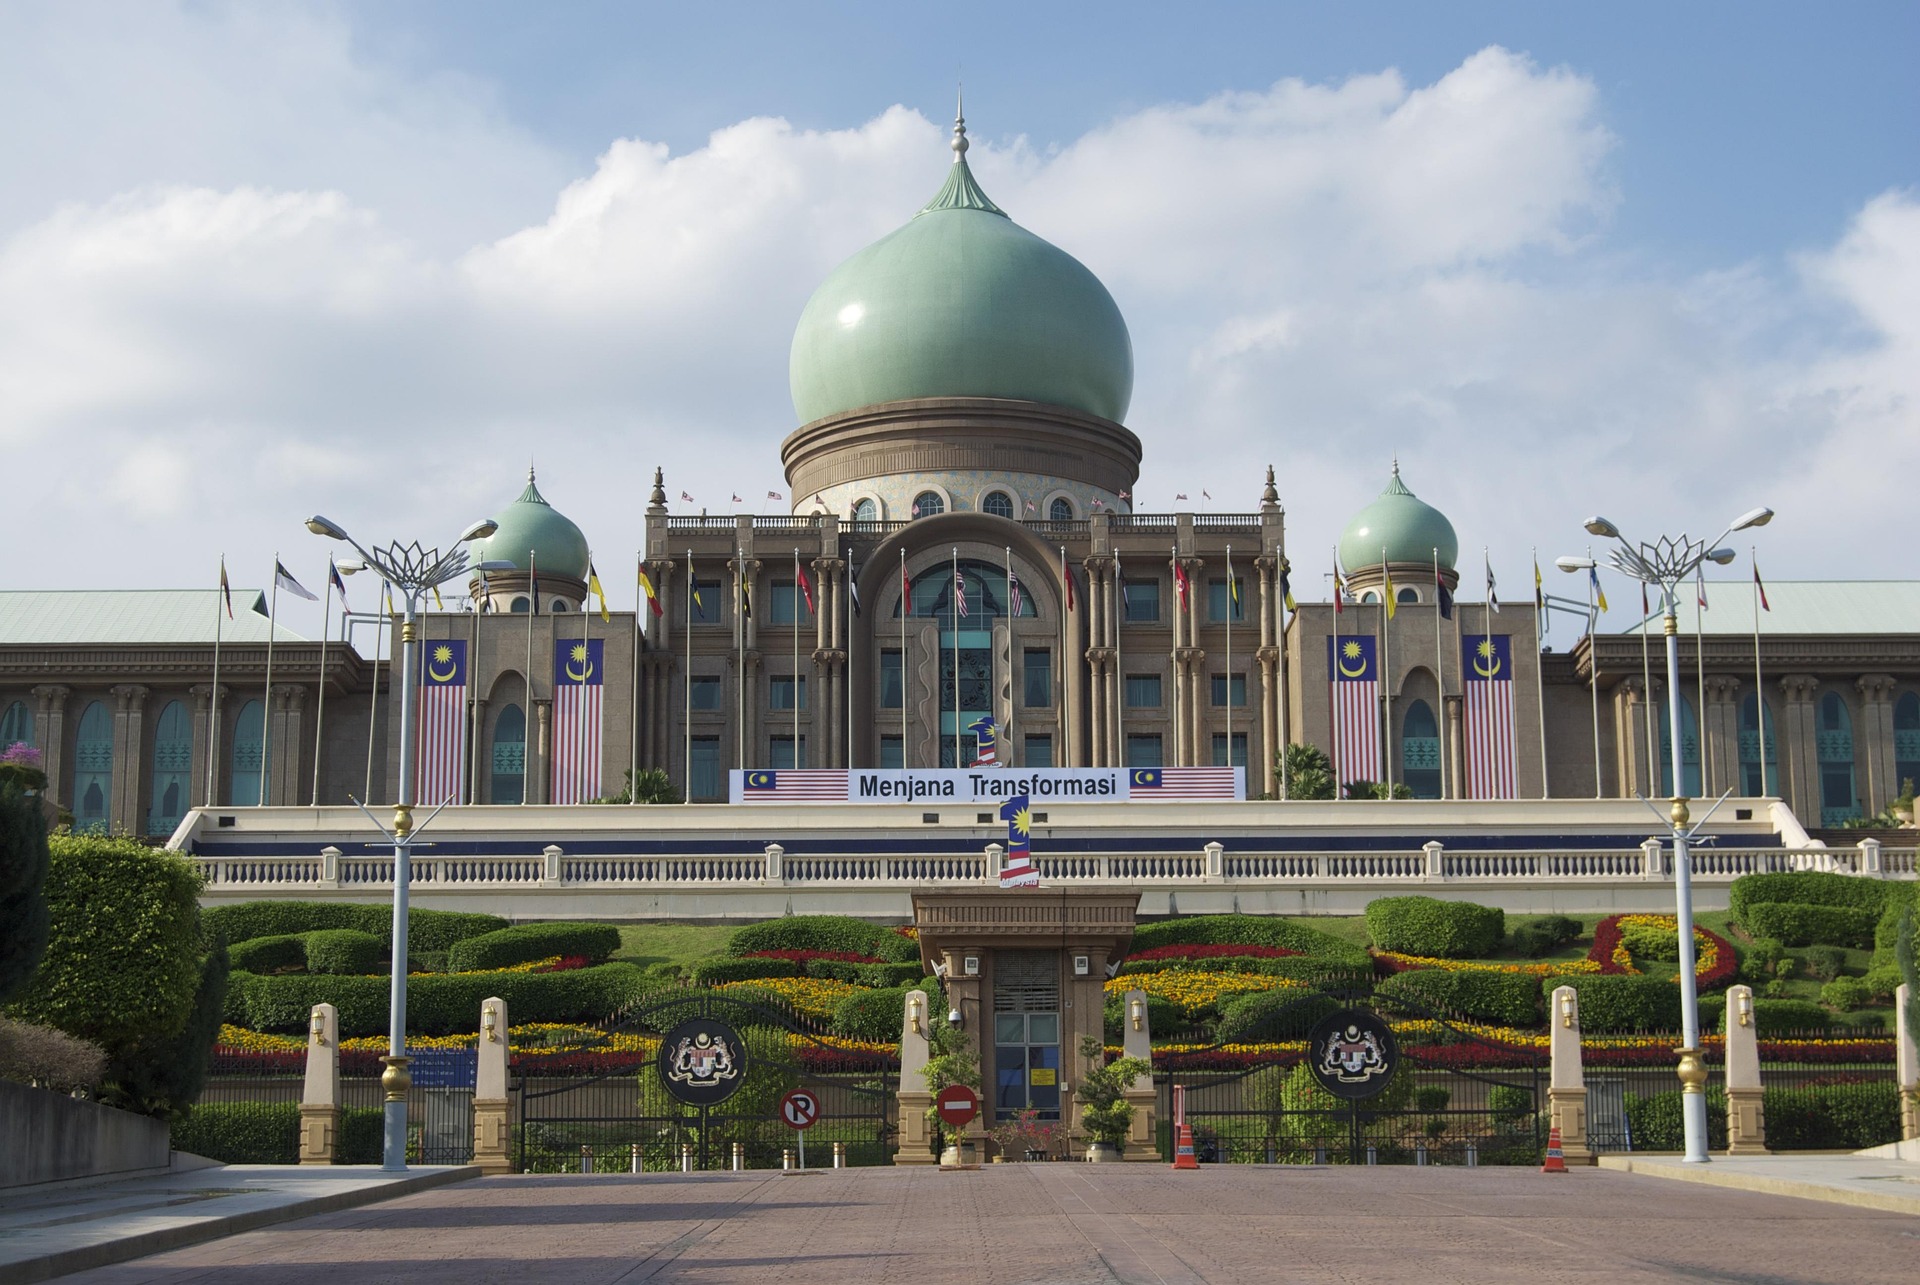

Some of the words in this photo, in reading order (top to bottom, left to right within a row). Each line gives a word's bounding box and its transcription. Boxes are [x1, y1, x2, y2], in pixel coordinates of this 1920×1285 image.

[860, 775, 954, 802] Menjana
[969, 773, 1116, 797] Transformasi
[1000, 877, 1038, 887] Malaysia
